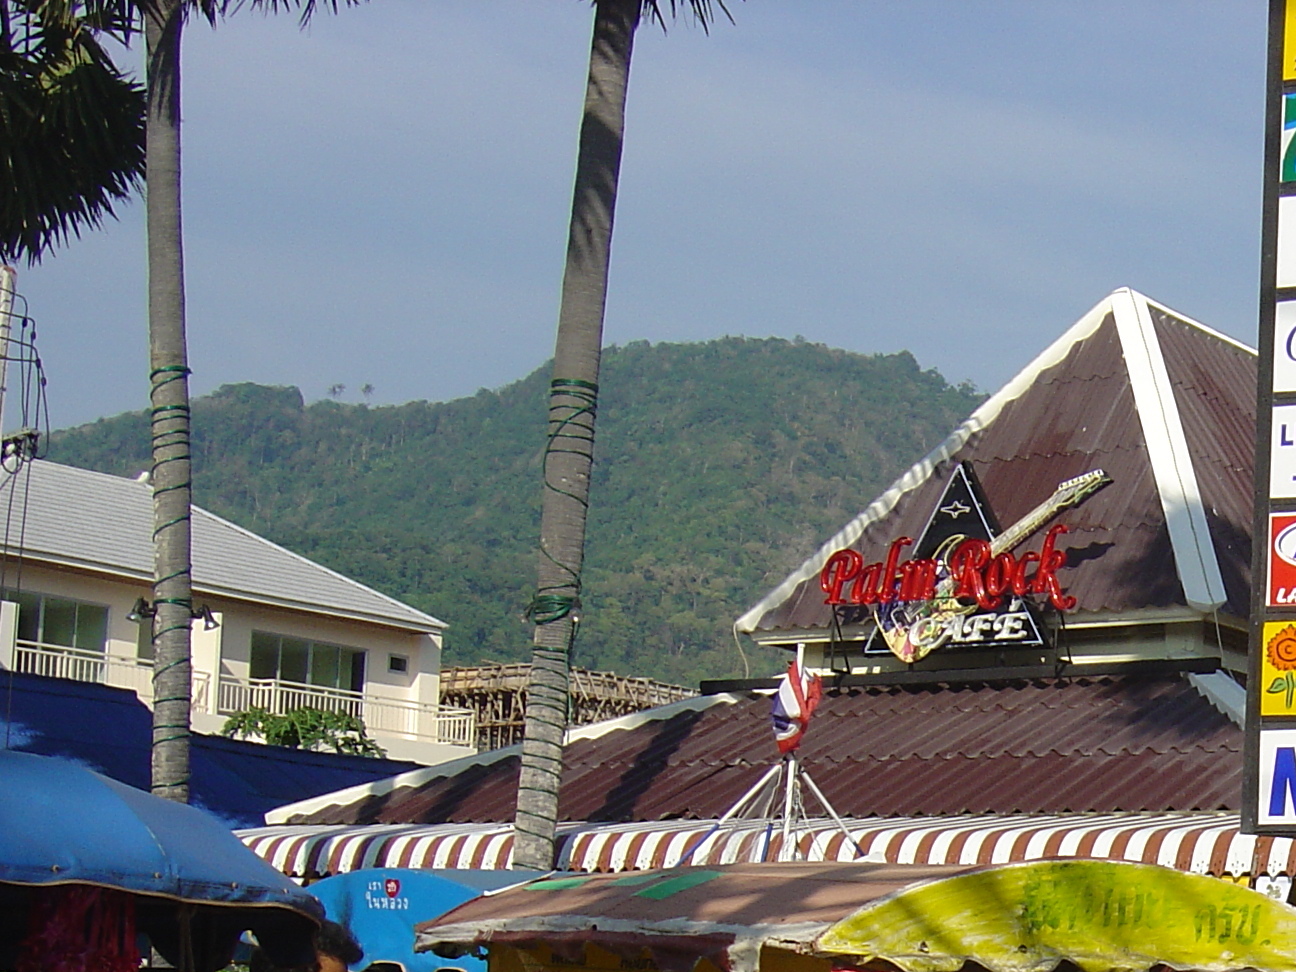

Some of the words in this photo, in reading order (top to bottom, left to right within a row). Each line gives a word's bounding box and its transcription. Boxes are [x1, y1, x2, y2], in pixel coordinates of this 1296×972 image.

[820, 536, 939, 605] Palm
[950, 524, 1078, 610] Rock
[909, 612, 1029, 650] CAFE
